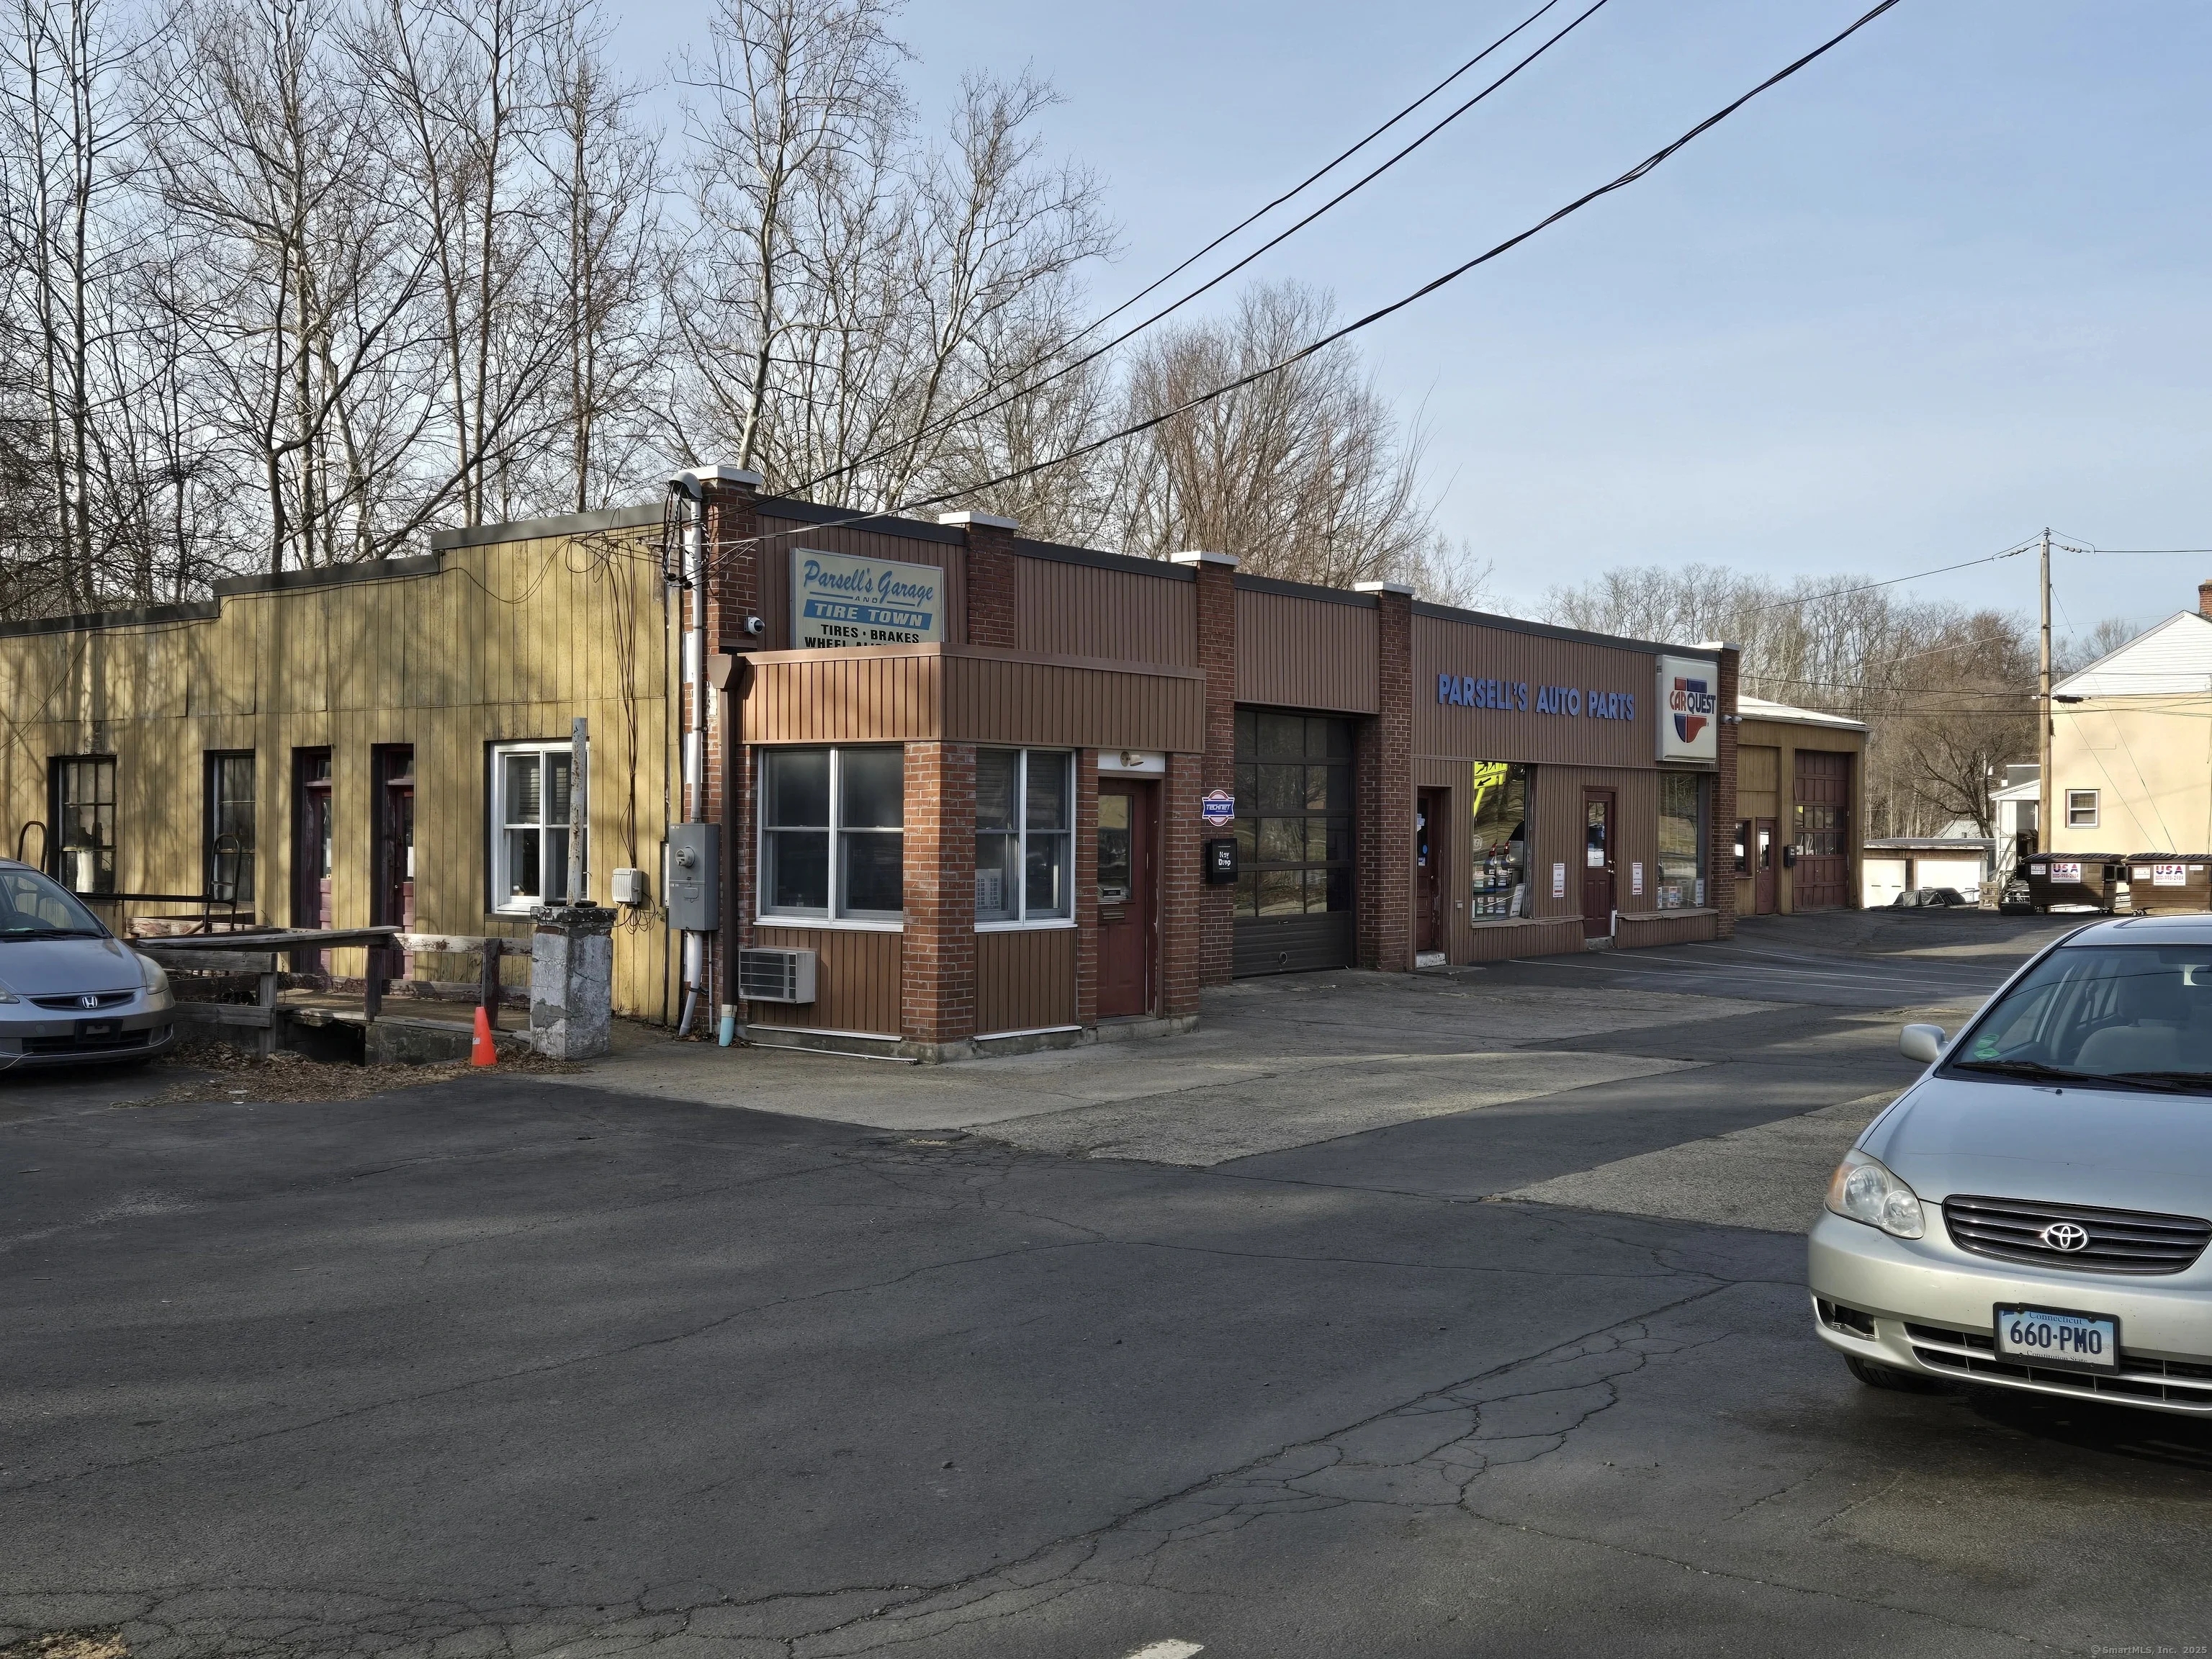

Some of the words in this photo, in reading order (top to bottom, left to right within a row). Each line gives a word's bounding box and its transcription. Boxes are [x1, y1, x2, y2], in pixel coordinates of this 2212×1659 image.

[804, 559, 873, 593] Parsell's
[878, 570, 933, 608] Garage
[814, 603, 858, 619] TIRE
[868, 609, 923, 626] TOWN
[820, 624, 858, 638] TIRES
[871, 629, 920, 643] BRAKES
[1438, 673, 1528, 711] PARSELL'S
[1535, 685, 1581, 716] AUTO
[1588, 690, 1635, 721] PARTS
[2053, 864, 2078, 873] USA
[2156, 866, 2183, 874] USA
[2029, 1311, 2083, 1325] Connecticut
